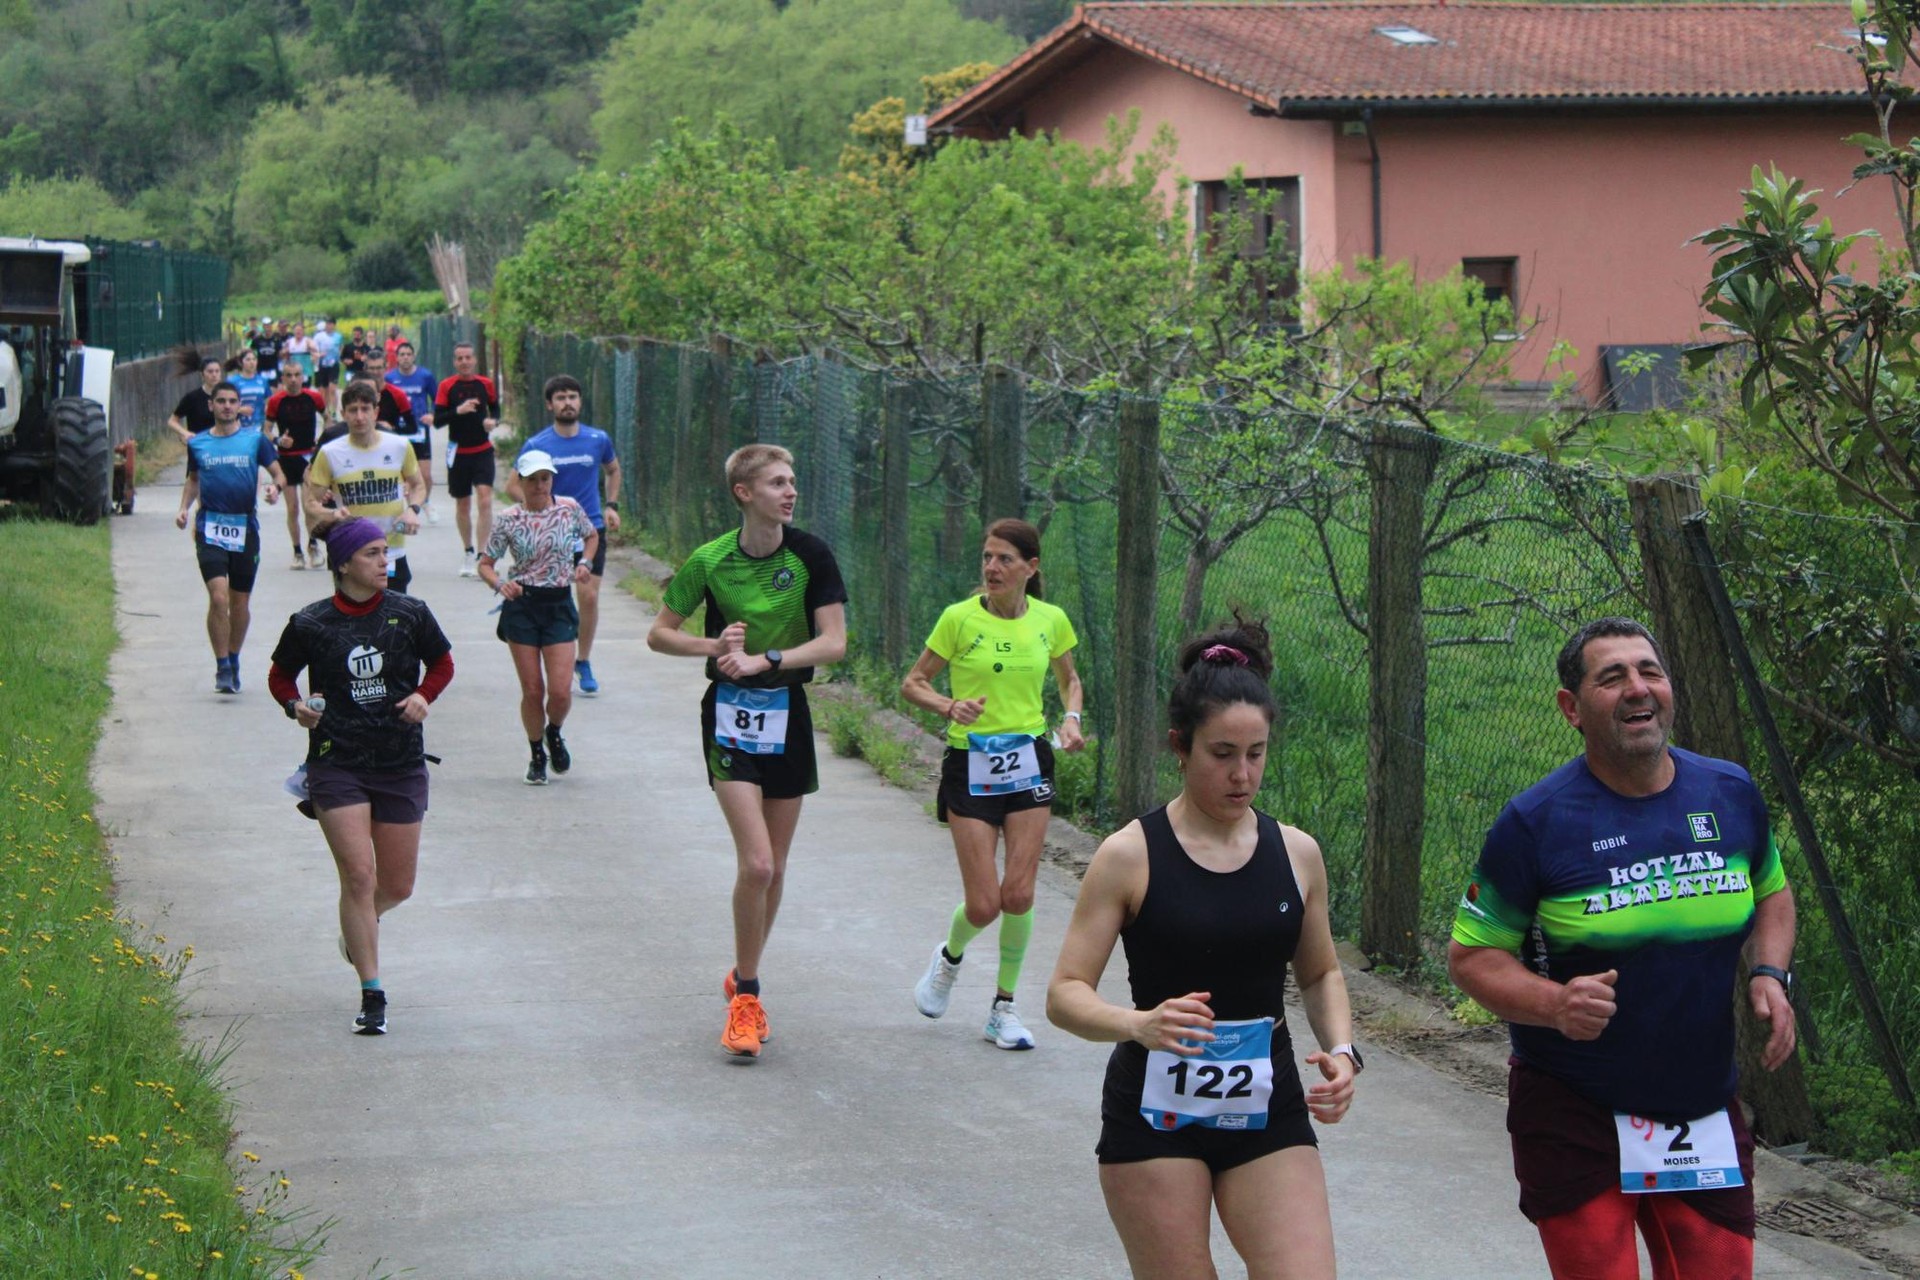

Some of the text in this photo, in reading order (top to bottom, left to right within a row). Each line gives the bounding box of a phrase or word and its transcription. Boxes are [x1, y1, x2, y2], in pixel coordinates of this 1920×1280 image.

[213, 525, 239, 538] 100
[996, 642, 1011, 652] LS
[350, 677, 384, 689] TRIKU
[351, 684, 386, 698] HARRI
[735, 710, 766, 732] 81
[989, 751, 1021, 775] 22
[1035, 784, 1051, 797] LS
[1692, 816, 1708, 825] EZE
[1694, 823, 1707, 832] NA
[1696, 830, 1713, 839] RRO
[1592, 835, 1628, 852] GOBIK
[1167, 1060, 1253, 1099] 122
[1664, 1120, 1693, 1152] 2
[1664, 1156, 1701, 1166] MOISES
